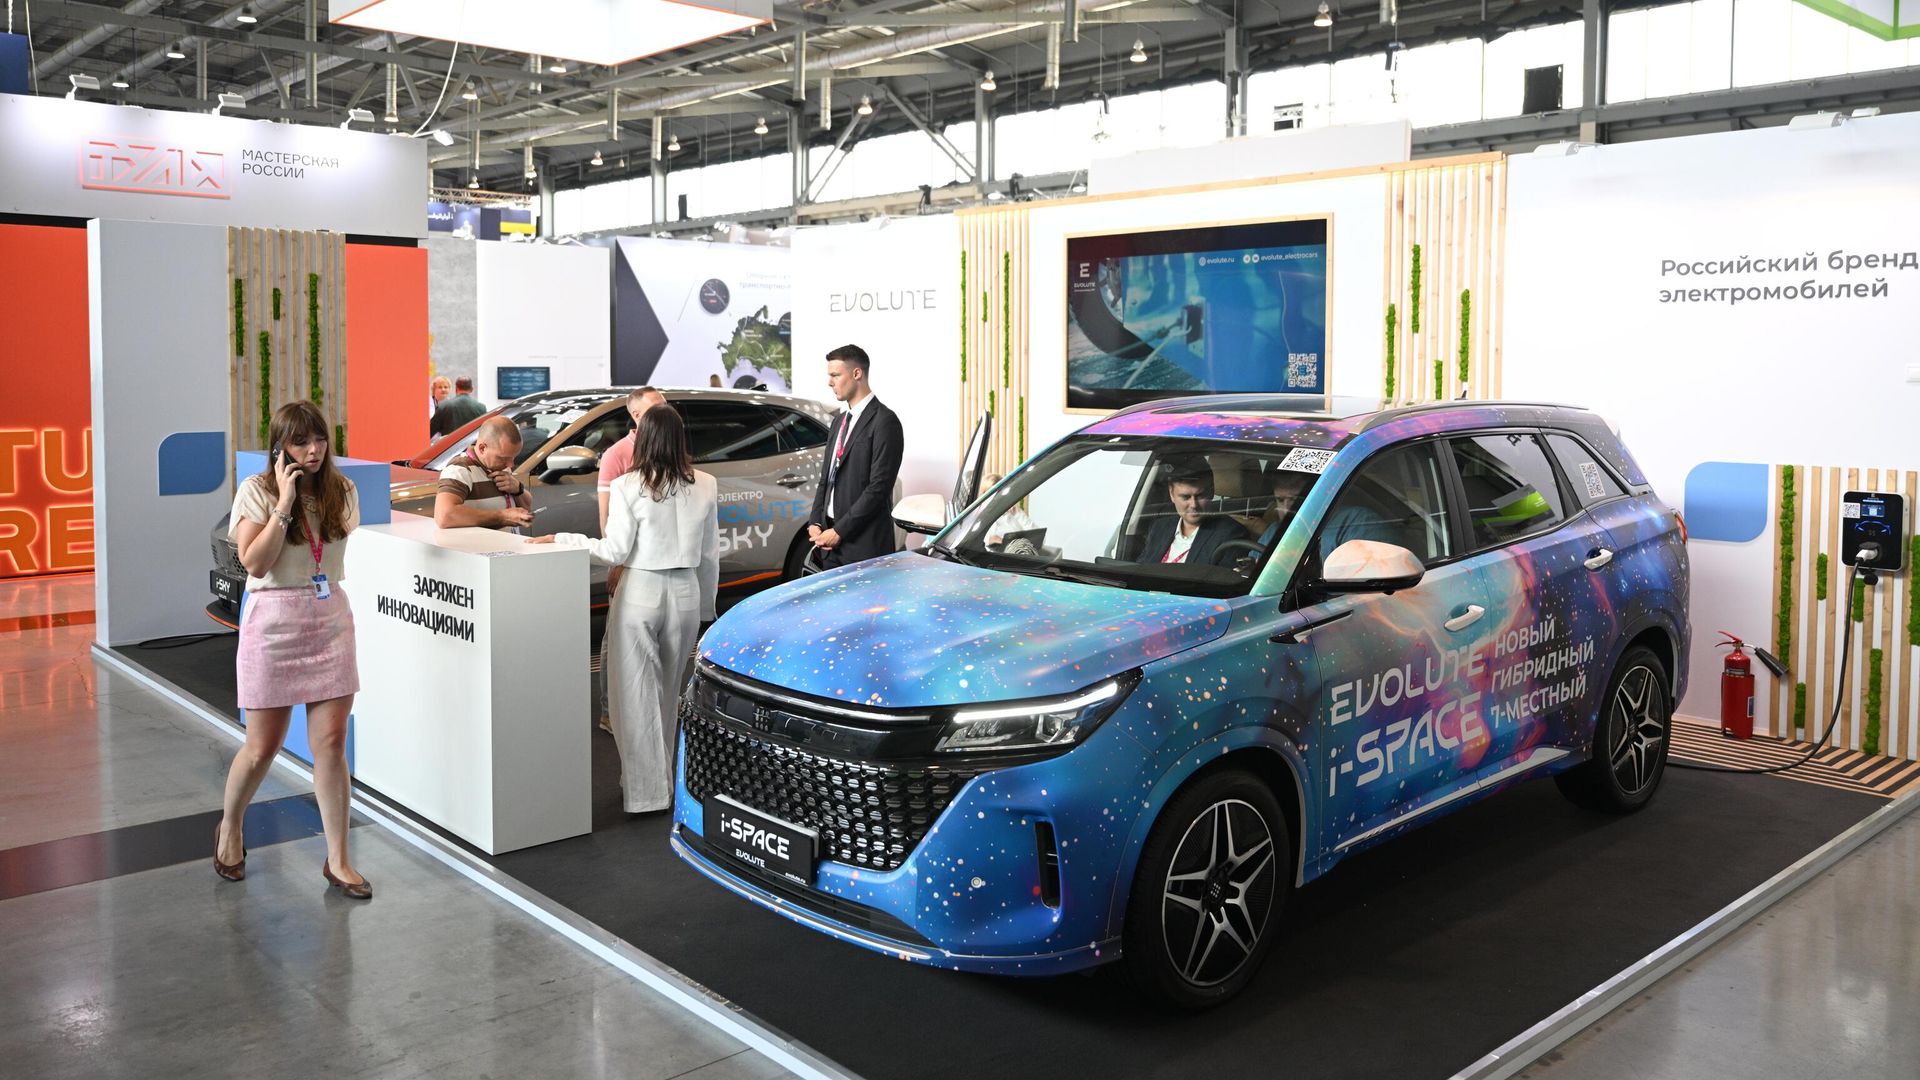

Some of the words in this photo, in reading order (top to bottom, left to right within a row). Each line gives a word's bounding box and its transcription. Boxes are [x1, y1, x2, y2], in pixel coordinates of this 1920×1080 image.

[242, 149, 339, 169] МАСТЕРСКАЯ
[242, 163, 304, 179] РОССИИ
[1207, 257, 1235, 265] evolute.ru
[1661, 252, 1818, 277] Российский
[1827, 250, 1919, 274] бренд
[830, 288, 937, 313] EVOLUTE
[1658, 277, 1889, 305] электромобилей
[718, 490, 764, 502] ЭЛЕКТРО
[0, 503, 95, 573] RE
[413, 574, 474, 610] ЗАРЯЖЕН
[377, 594, 475, 643] ИННОВАЦИЯМИ
[1494, 614, 1556, 659] НОВЫЙ
[1491, 636, 1595, 693] ГИБРИДНЫЙ
[1330, 643, 1484, 726] EVOLUTE
[1490, 670, 1587, 729] 7-МЕСТНЫЙ
[1328, 691, 1483, 798] i-SPACE
[721, 813, 790, 861] i-SPACE
[735, 848, 765, 868] EVOLUTE
